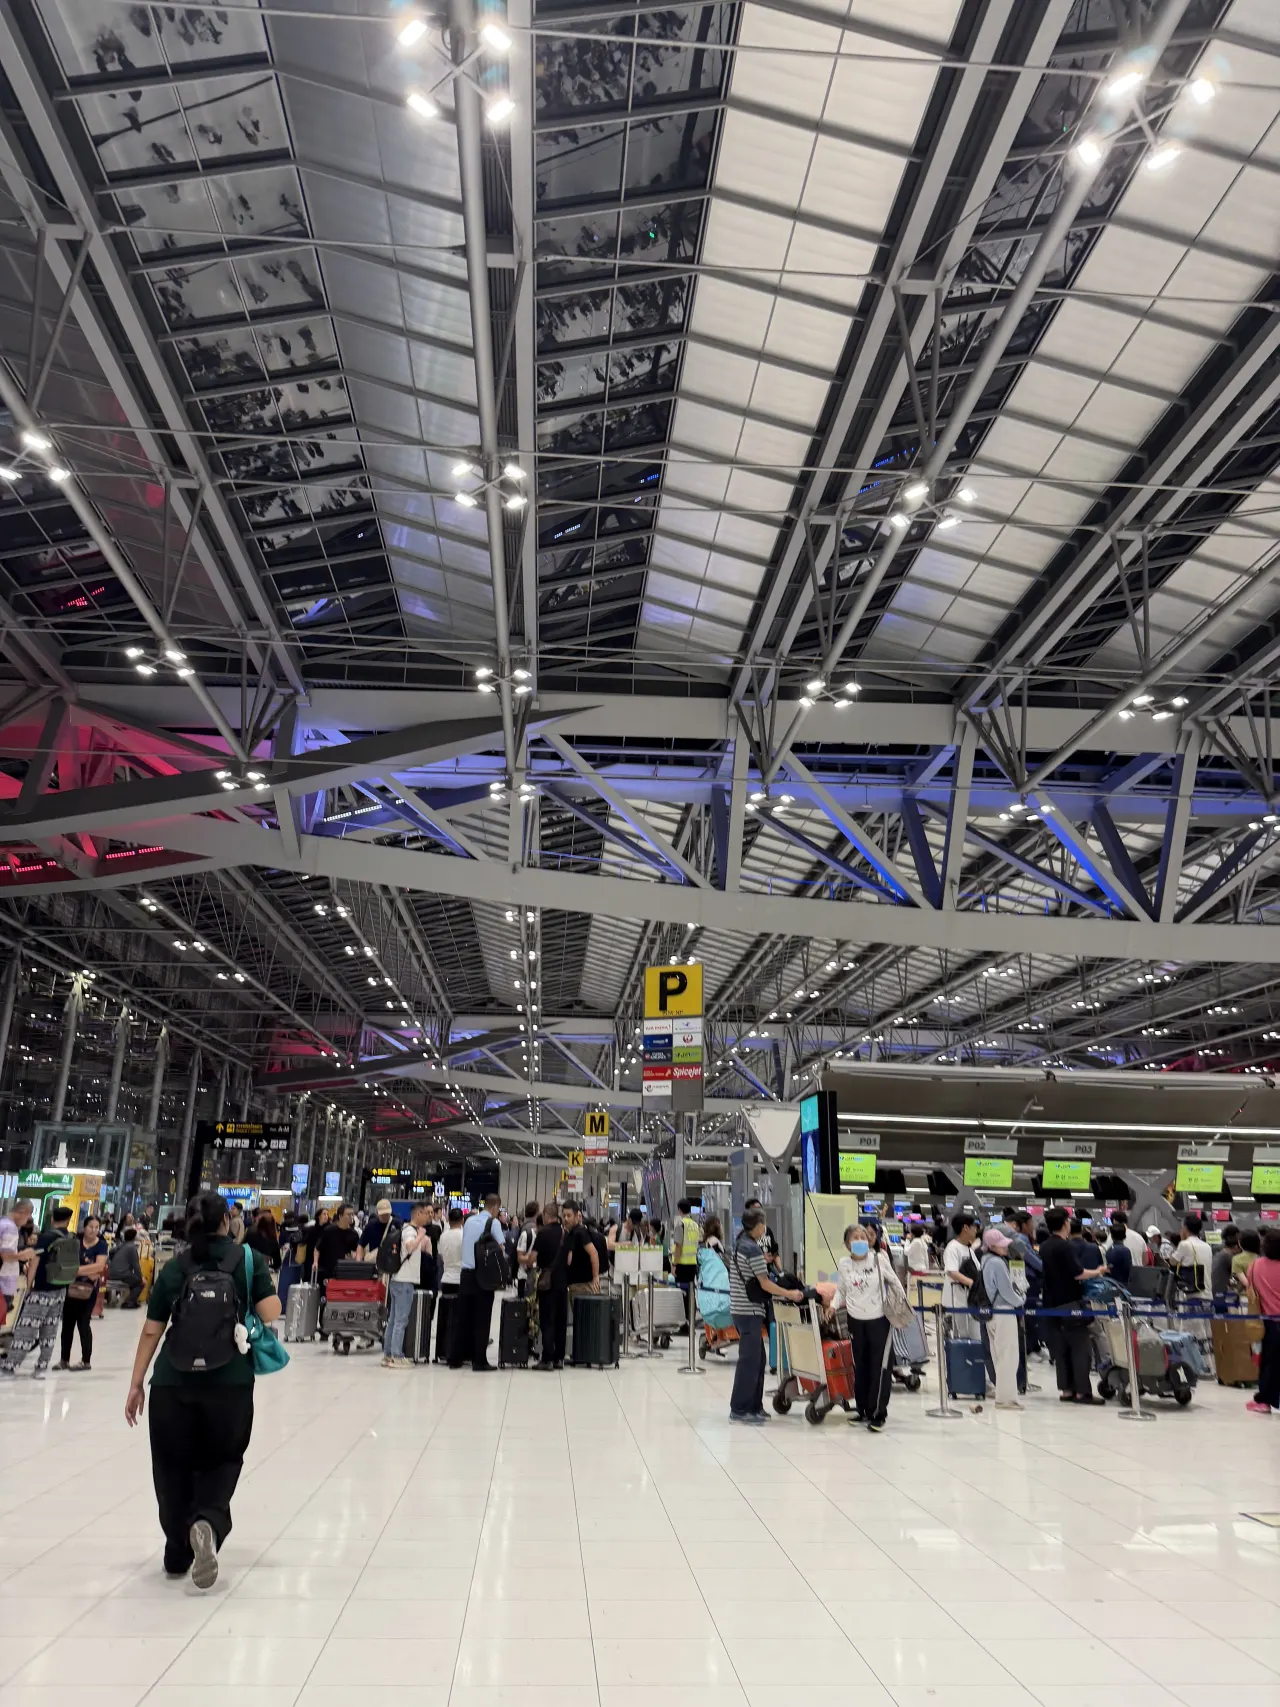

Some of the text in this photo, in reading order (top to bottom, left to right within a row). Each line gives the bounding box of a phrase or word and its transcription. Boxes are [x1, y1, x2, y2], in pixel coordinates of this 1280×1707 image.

[659, 971, 688, 1011] P
[589, 1115, 605, 1133] M
[968, 1141, 986, 1150] P02
[1075, 1145, 1093, 1153] P03
[1181, 1148, 1198, 1156] P04
[571, 1153, 581, 1165] K
[26, 1173, 43, 1182] ATM
